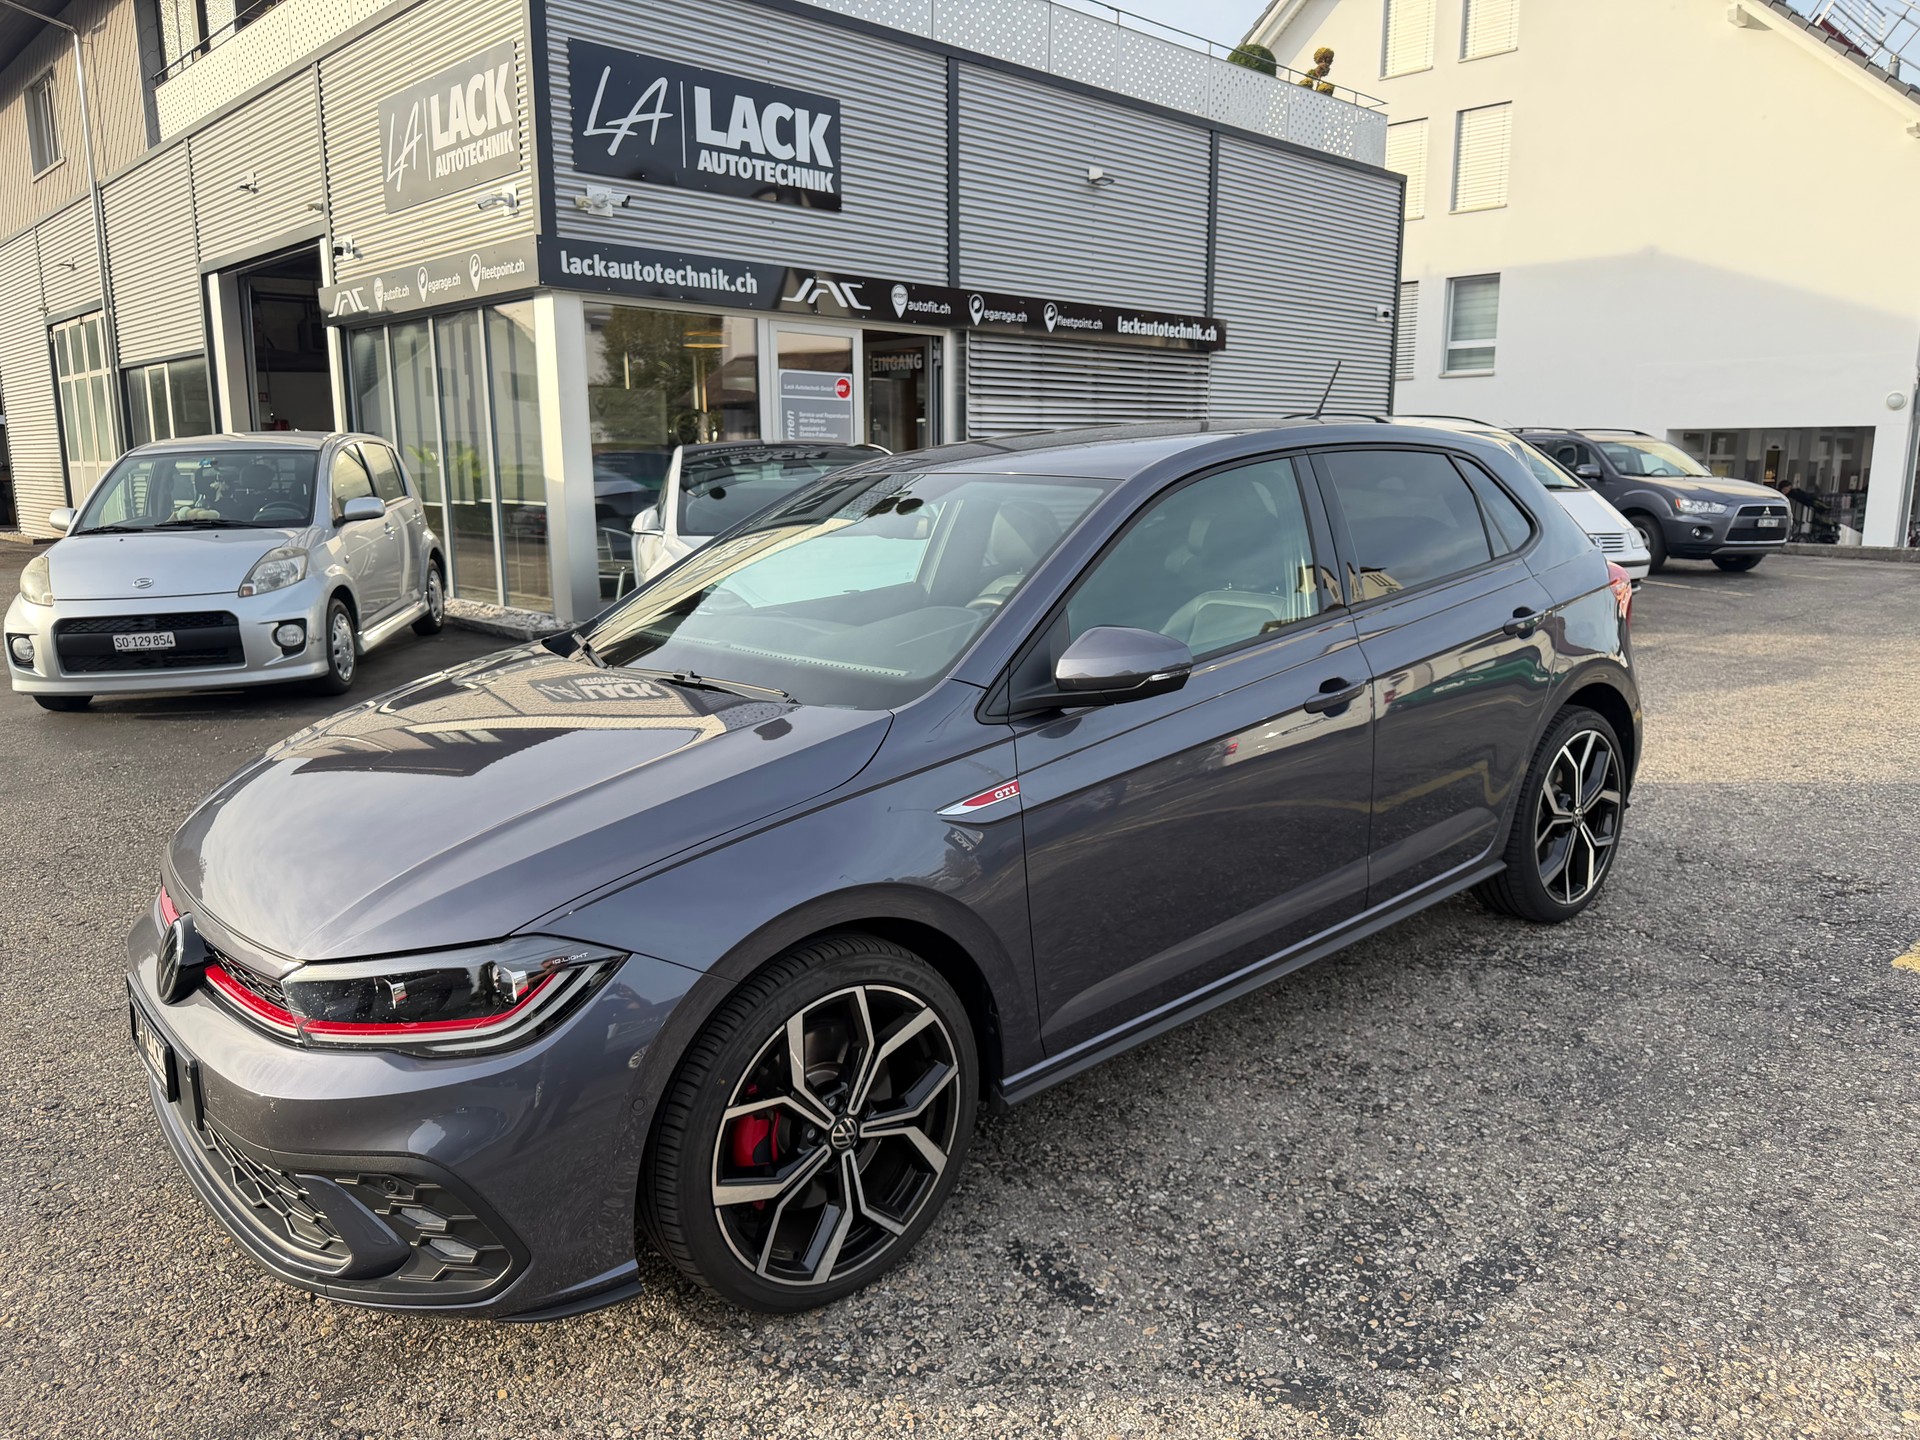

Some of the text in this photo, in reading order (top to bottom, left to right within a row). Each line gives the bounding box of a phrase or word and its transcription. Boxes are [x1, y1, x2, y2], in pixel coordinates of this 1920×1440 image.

[430, 61, 513, 151] LACK
[694, 86, 834, 168] LACK
[435, 128, 515, 178] AUTOTECHNIK
[697, 149, 834, 193] AUTOTECHNIK
[481, 258, 525, 280] fleetpoint.ch
[560, 250, 757, 294] lackautotechnik.ch
[428, 273, 461, 293] egarage.ch
[383, 285, 410, 302] autofit.ch
[908, 300, 951, 315] autofit.ch
[983, 308, 1028, 323] egarage.ch
[1056, 315, 1103, 330] fleetpoint.ch
[1117, 316, 1217, 342] lackautotechnik.ch
[872, 354, 923, 372] EINGANG
[153, 635, 173, 646] 854
[995, 785, 1017, 799] GTI
